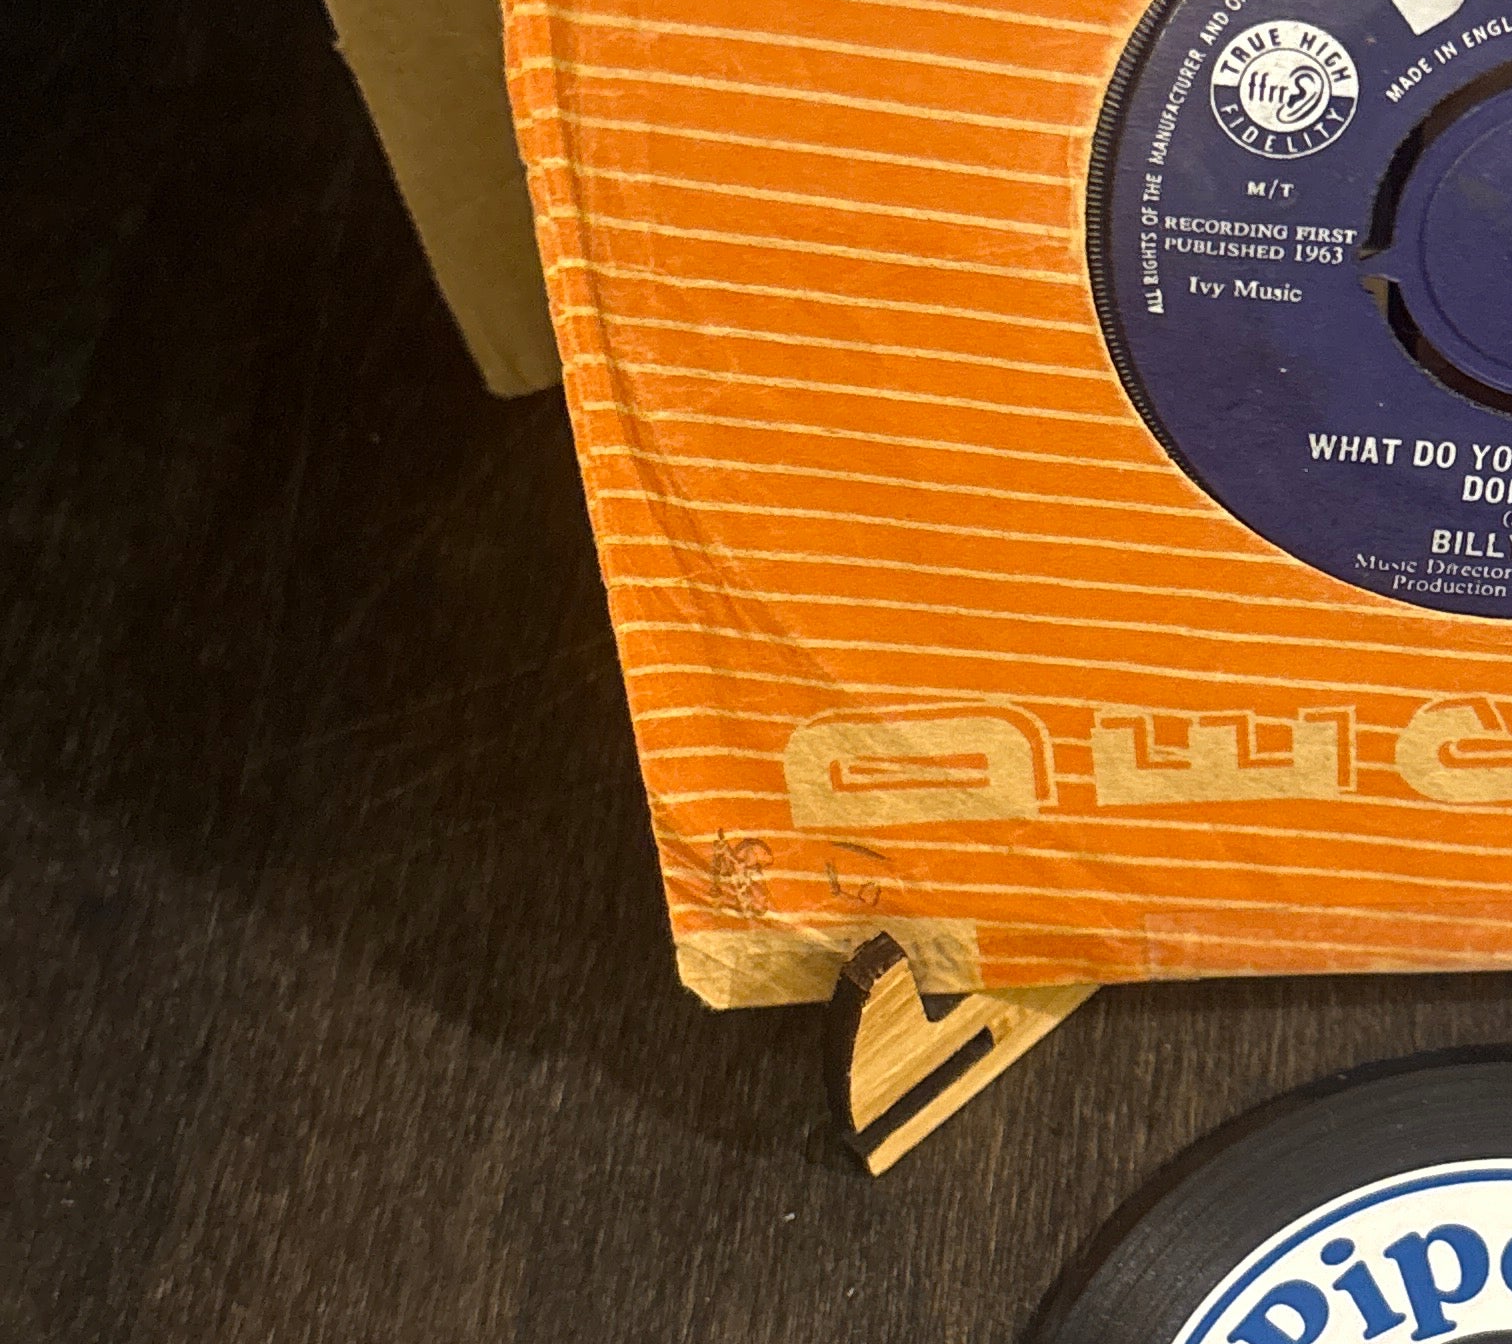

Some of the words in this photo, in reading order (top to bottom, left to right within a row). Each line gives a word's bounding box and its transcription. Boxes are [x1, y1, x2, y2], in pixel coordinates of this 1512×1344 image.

[1200, 13, 1230, 46] AND
[1220, 28, 1281, 74] TRUE
[1300, 31, 1352, 83] HIGH
[1386, 58, 1433, 103] MADE
[1434, 41, 1458, 64] IN
[1249, 71, 1289, 104] ffrr
[1148, 50, 1207, 166] MANUFACTURER
[1220, 105, 1345, 154] FIDELITY
[1142, 173, 1162, 202] THE
[1247, 179, 1295, 200] M/T
[1141, 207, 1159, 226] OF
[1164, 216, 1288, 240] RECORDING
[1295, 225, 1357, 245] FIRST
[1141, 232, 1158, 285] RIGHTS
[1164, 237, 1286, 261] PUBLISHED
[1294, 244, 1344, 265] 1963
[1141, 288, 1164, 314] ALL
[1189, 276, 1225, 298] Ivy
[1234, 279, 1303, 303] Music
[1308, 433, 1403, 465] WHAT
[1413, 440, 1458, 469] DO
